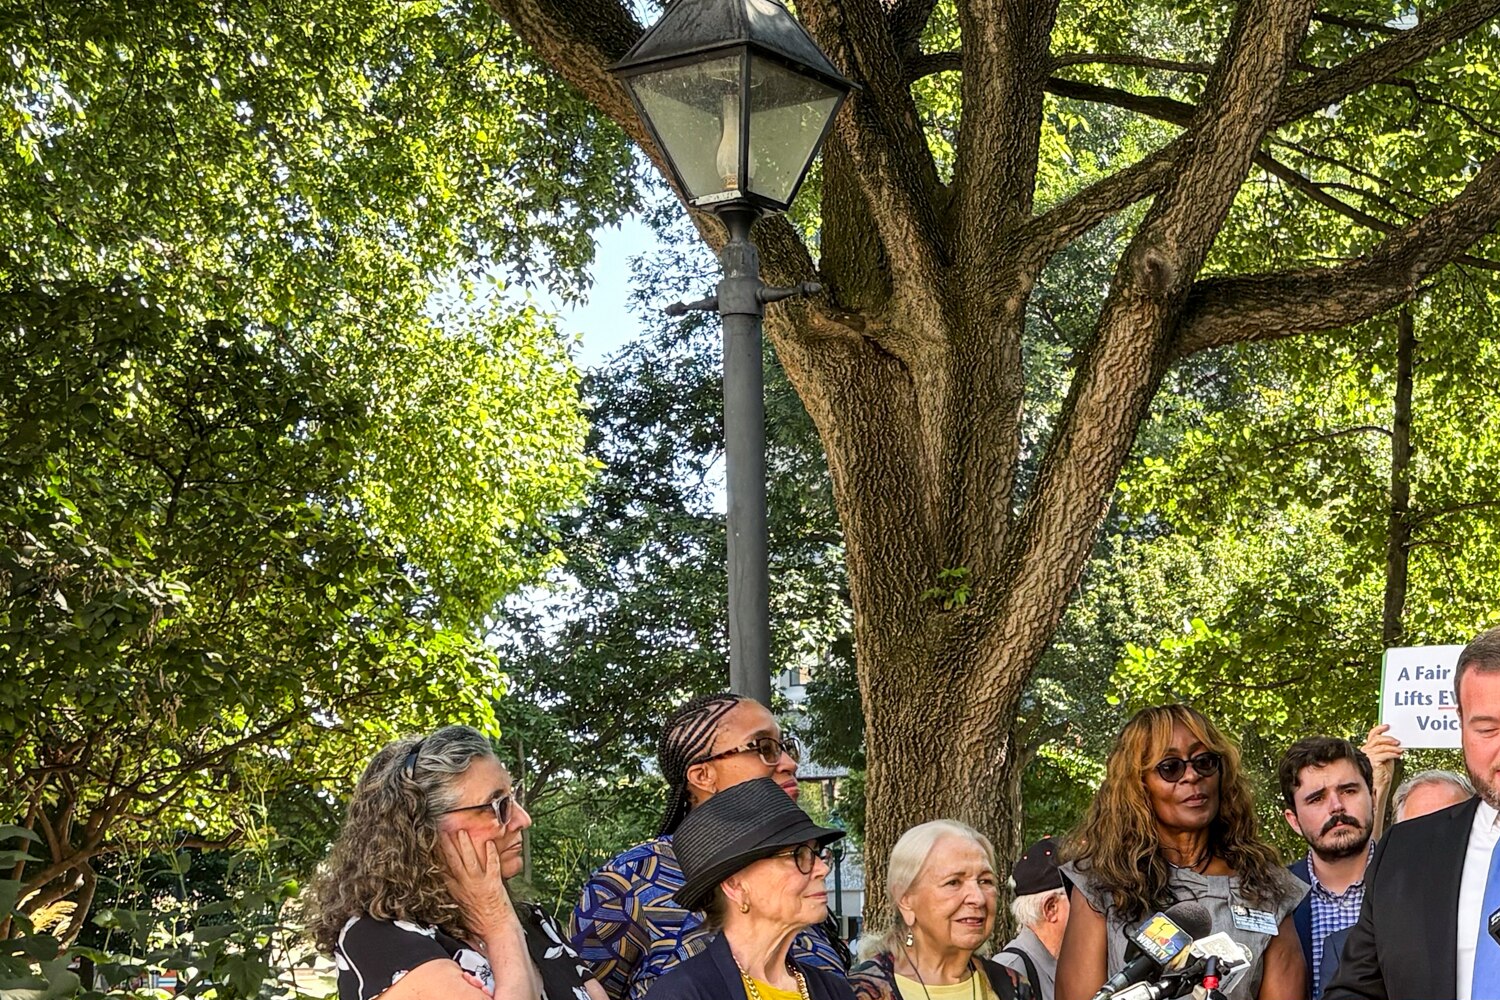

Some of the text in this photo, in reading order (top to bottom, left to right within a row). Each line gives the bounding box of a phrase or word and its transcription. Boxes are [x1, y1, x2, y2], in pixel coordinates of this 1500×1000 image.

[1397, 664, 1451, 682] A Fair
[1394, 690, 1433, 707] Lifts
[1416, 714, 1462, 731] Voic
